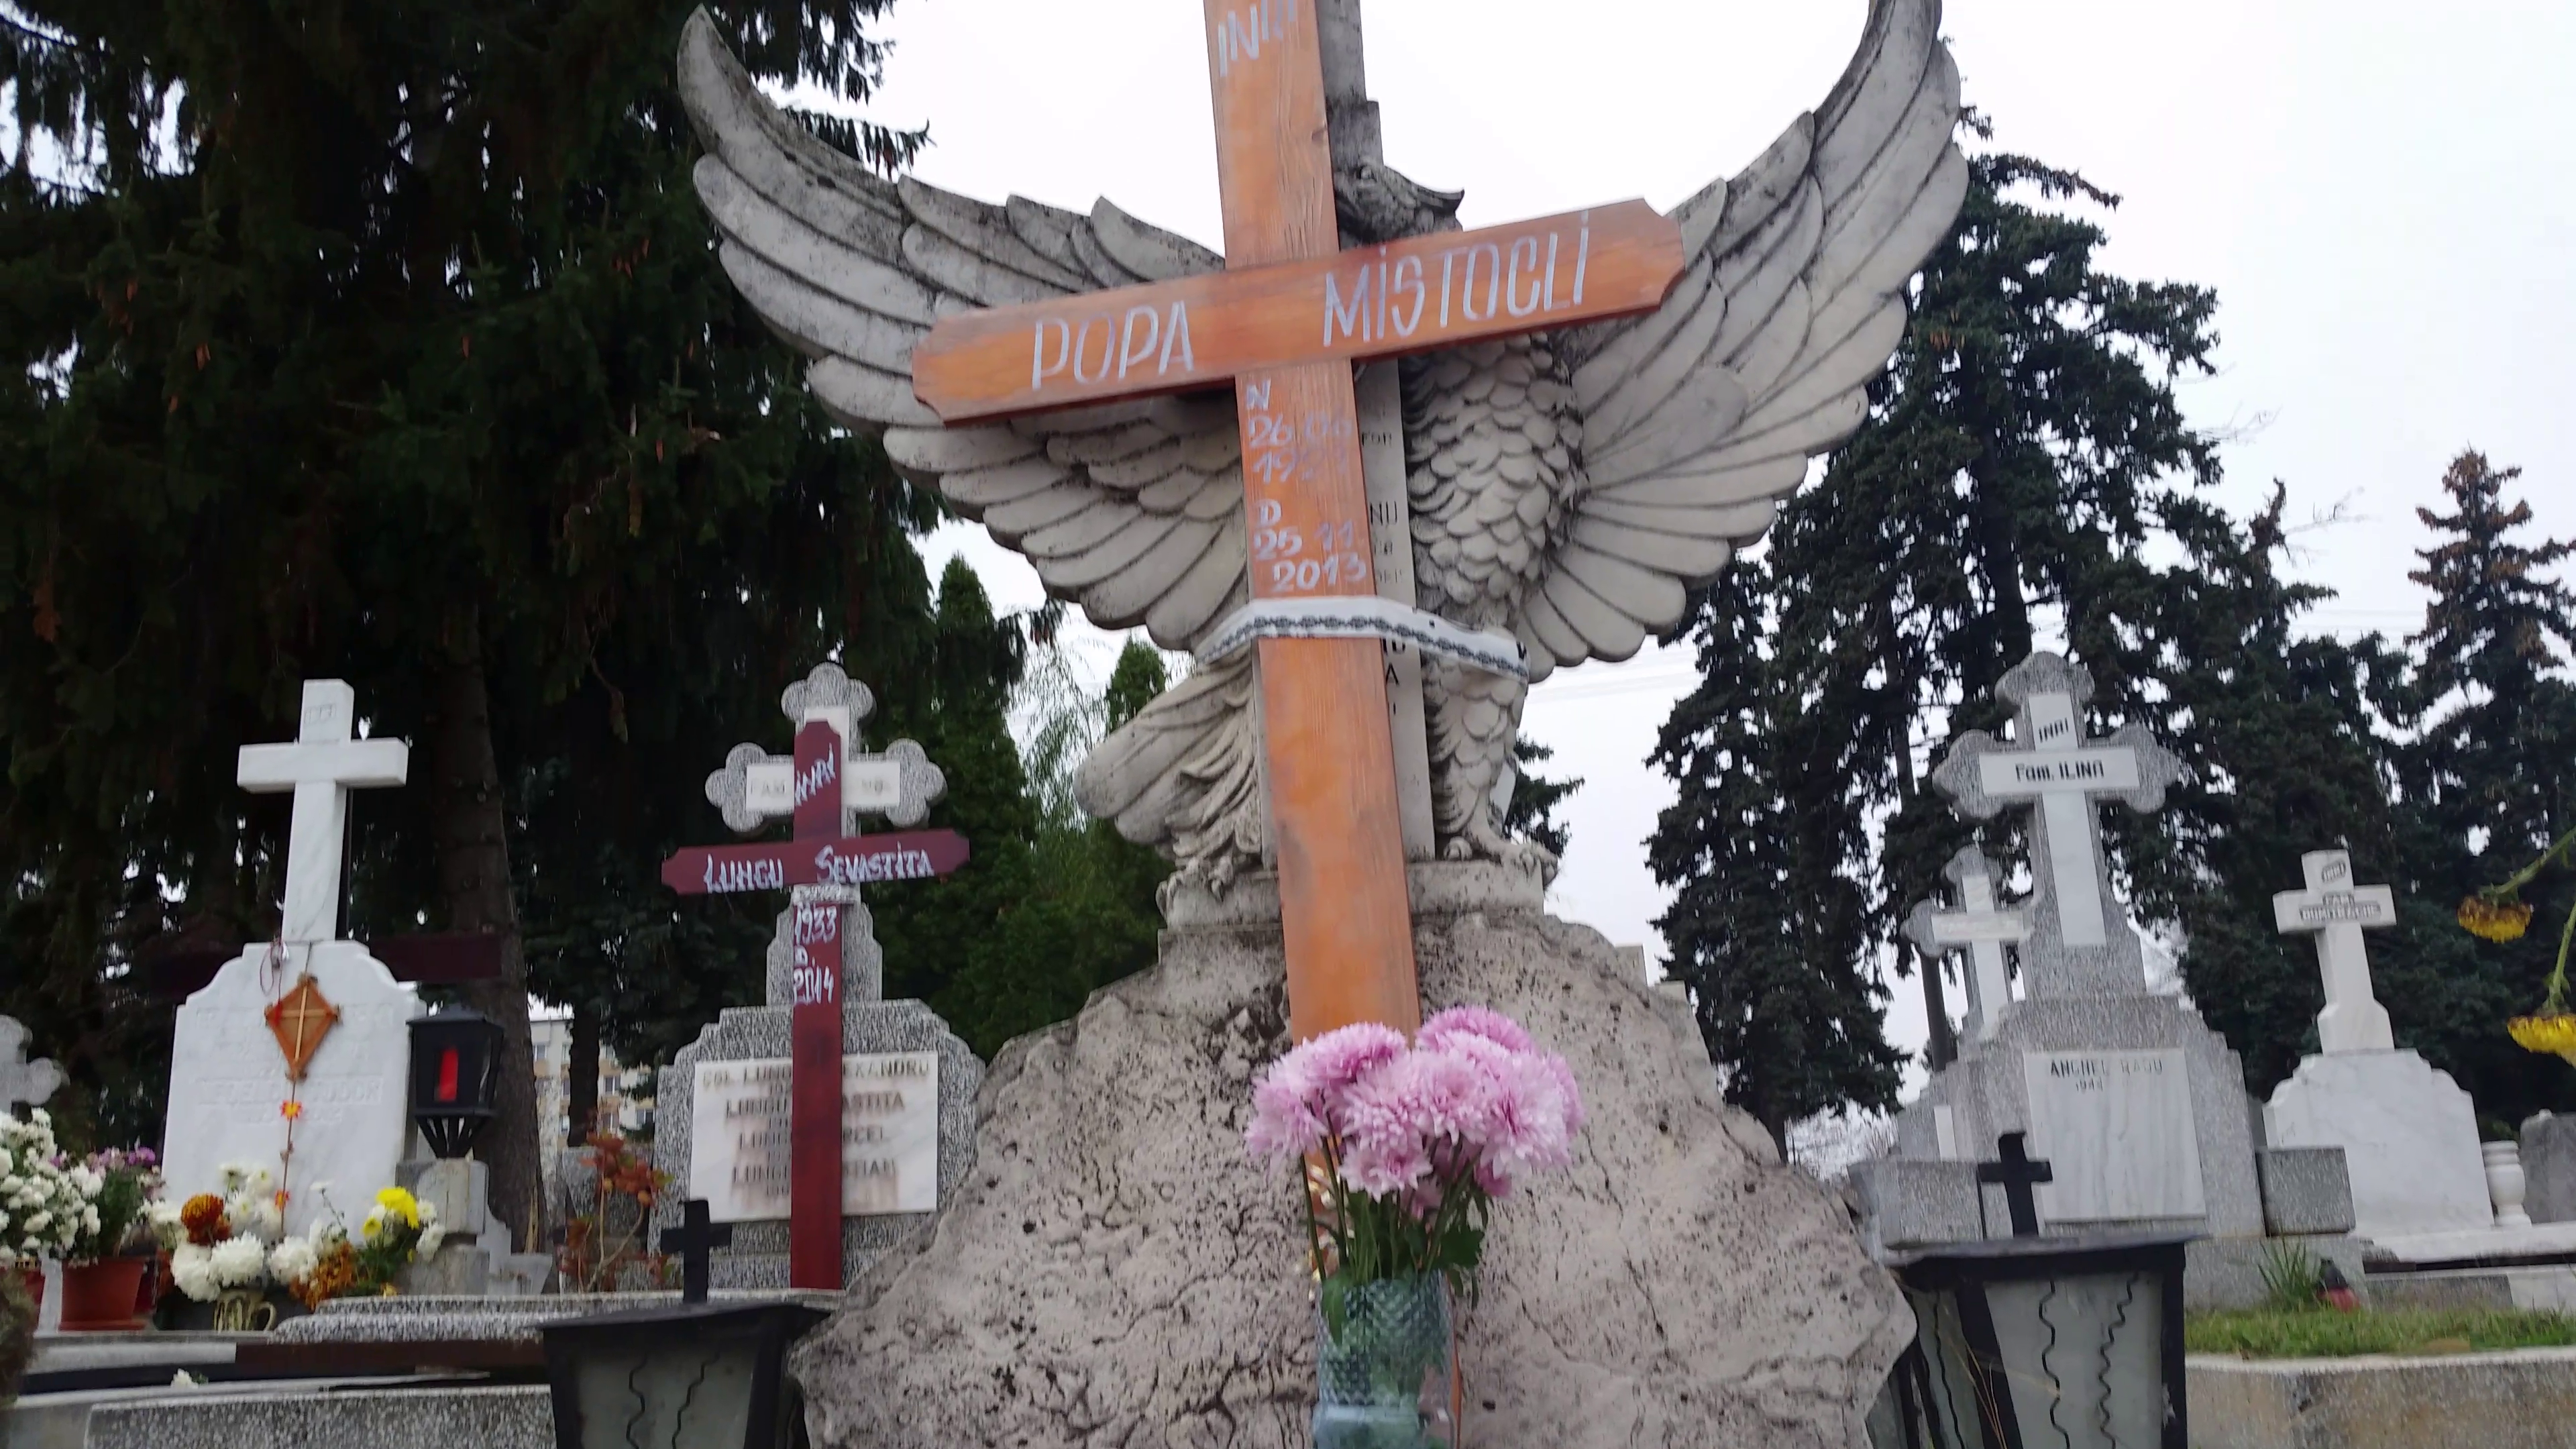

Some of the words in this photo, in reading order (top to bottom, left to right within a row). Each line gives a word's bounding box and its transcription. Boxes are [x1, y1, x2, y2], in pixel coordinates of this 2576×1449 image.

[1032, 300, 1194, 391] POPA
[1324, 210, 1589, 347] MISTOCLI
[1246, 379, 1271, 411] N
[1258, 499, 1283, 527] D
[1254, 526, 1303, 559] 25
[1314, 519, 1354, 551] 11
[1273, 551, 1367, 592] 2013
[794, 903, 837, 946] 1933
[794, 965, 835, 1004] 2014
